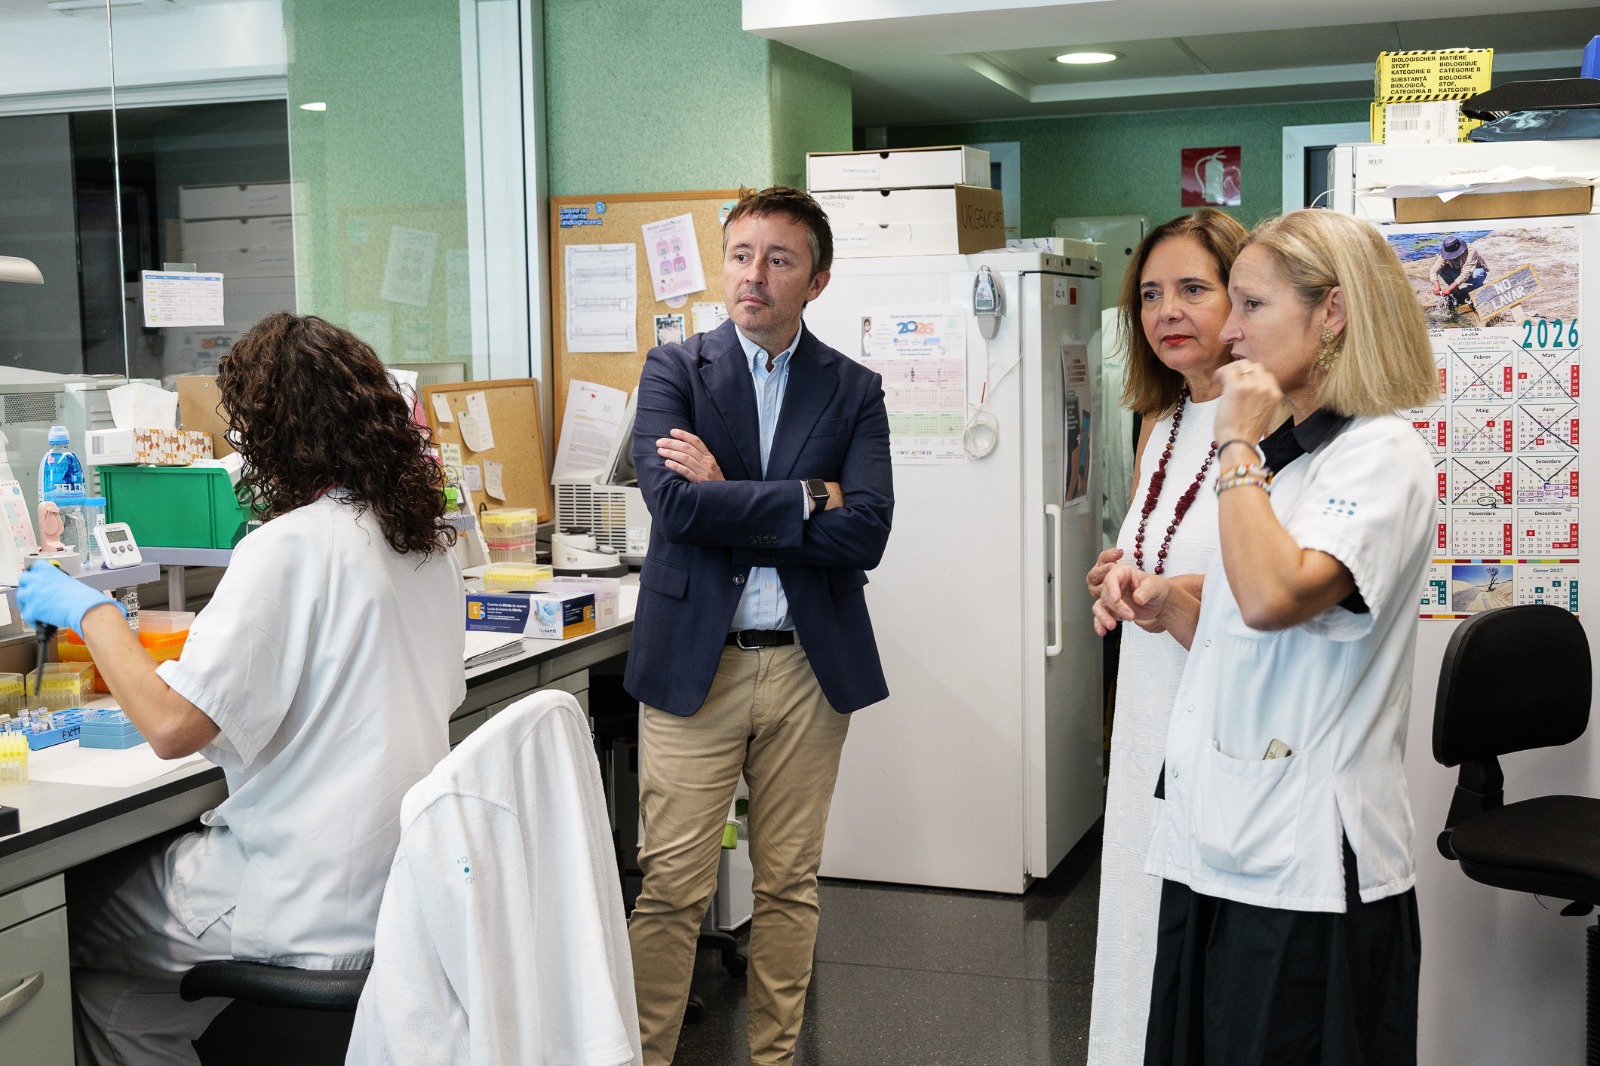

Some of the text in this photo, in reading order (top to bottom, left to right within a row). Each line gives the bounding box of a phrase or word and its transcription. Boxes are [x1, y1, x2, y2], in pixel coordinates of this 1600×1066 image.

[1494, 279, 1512, 294] NO
[1491, 286, 1526, 310] LAVAR
[1522, 318, 1579, 348] 2026
[473, 606, 478, 614] S
